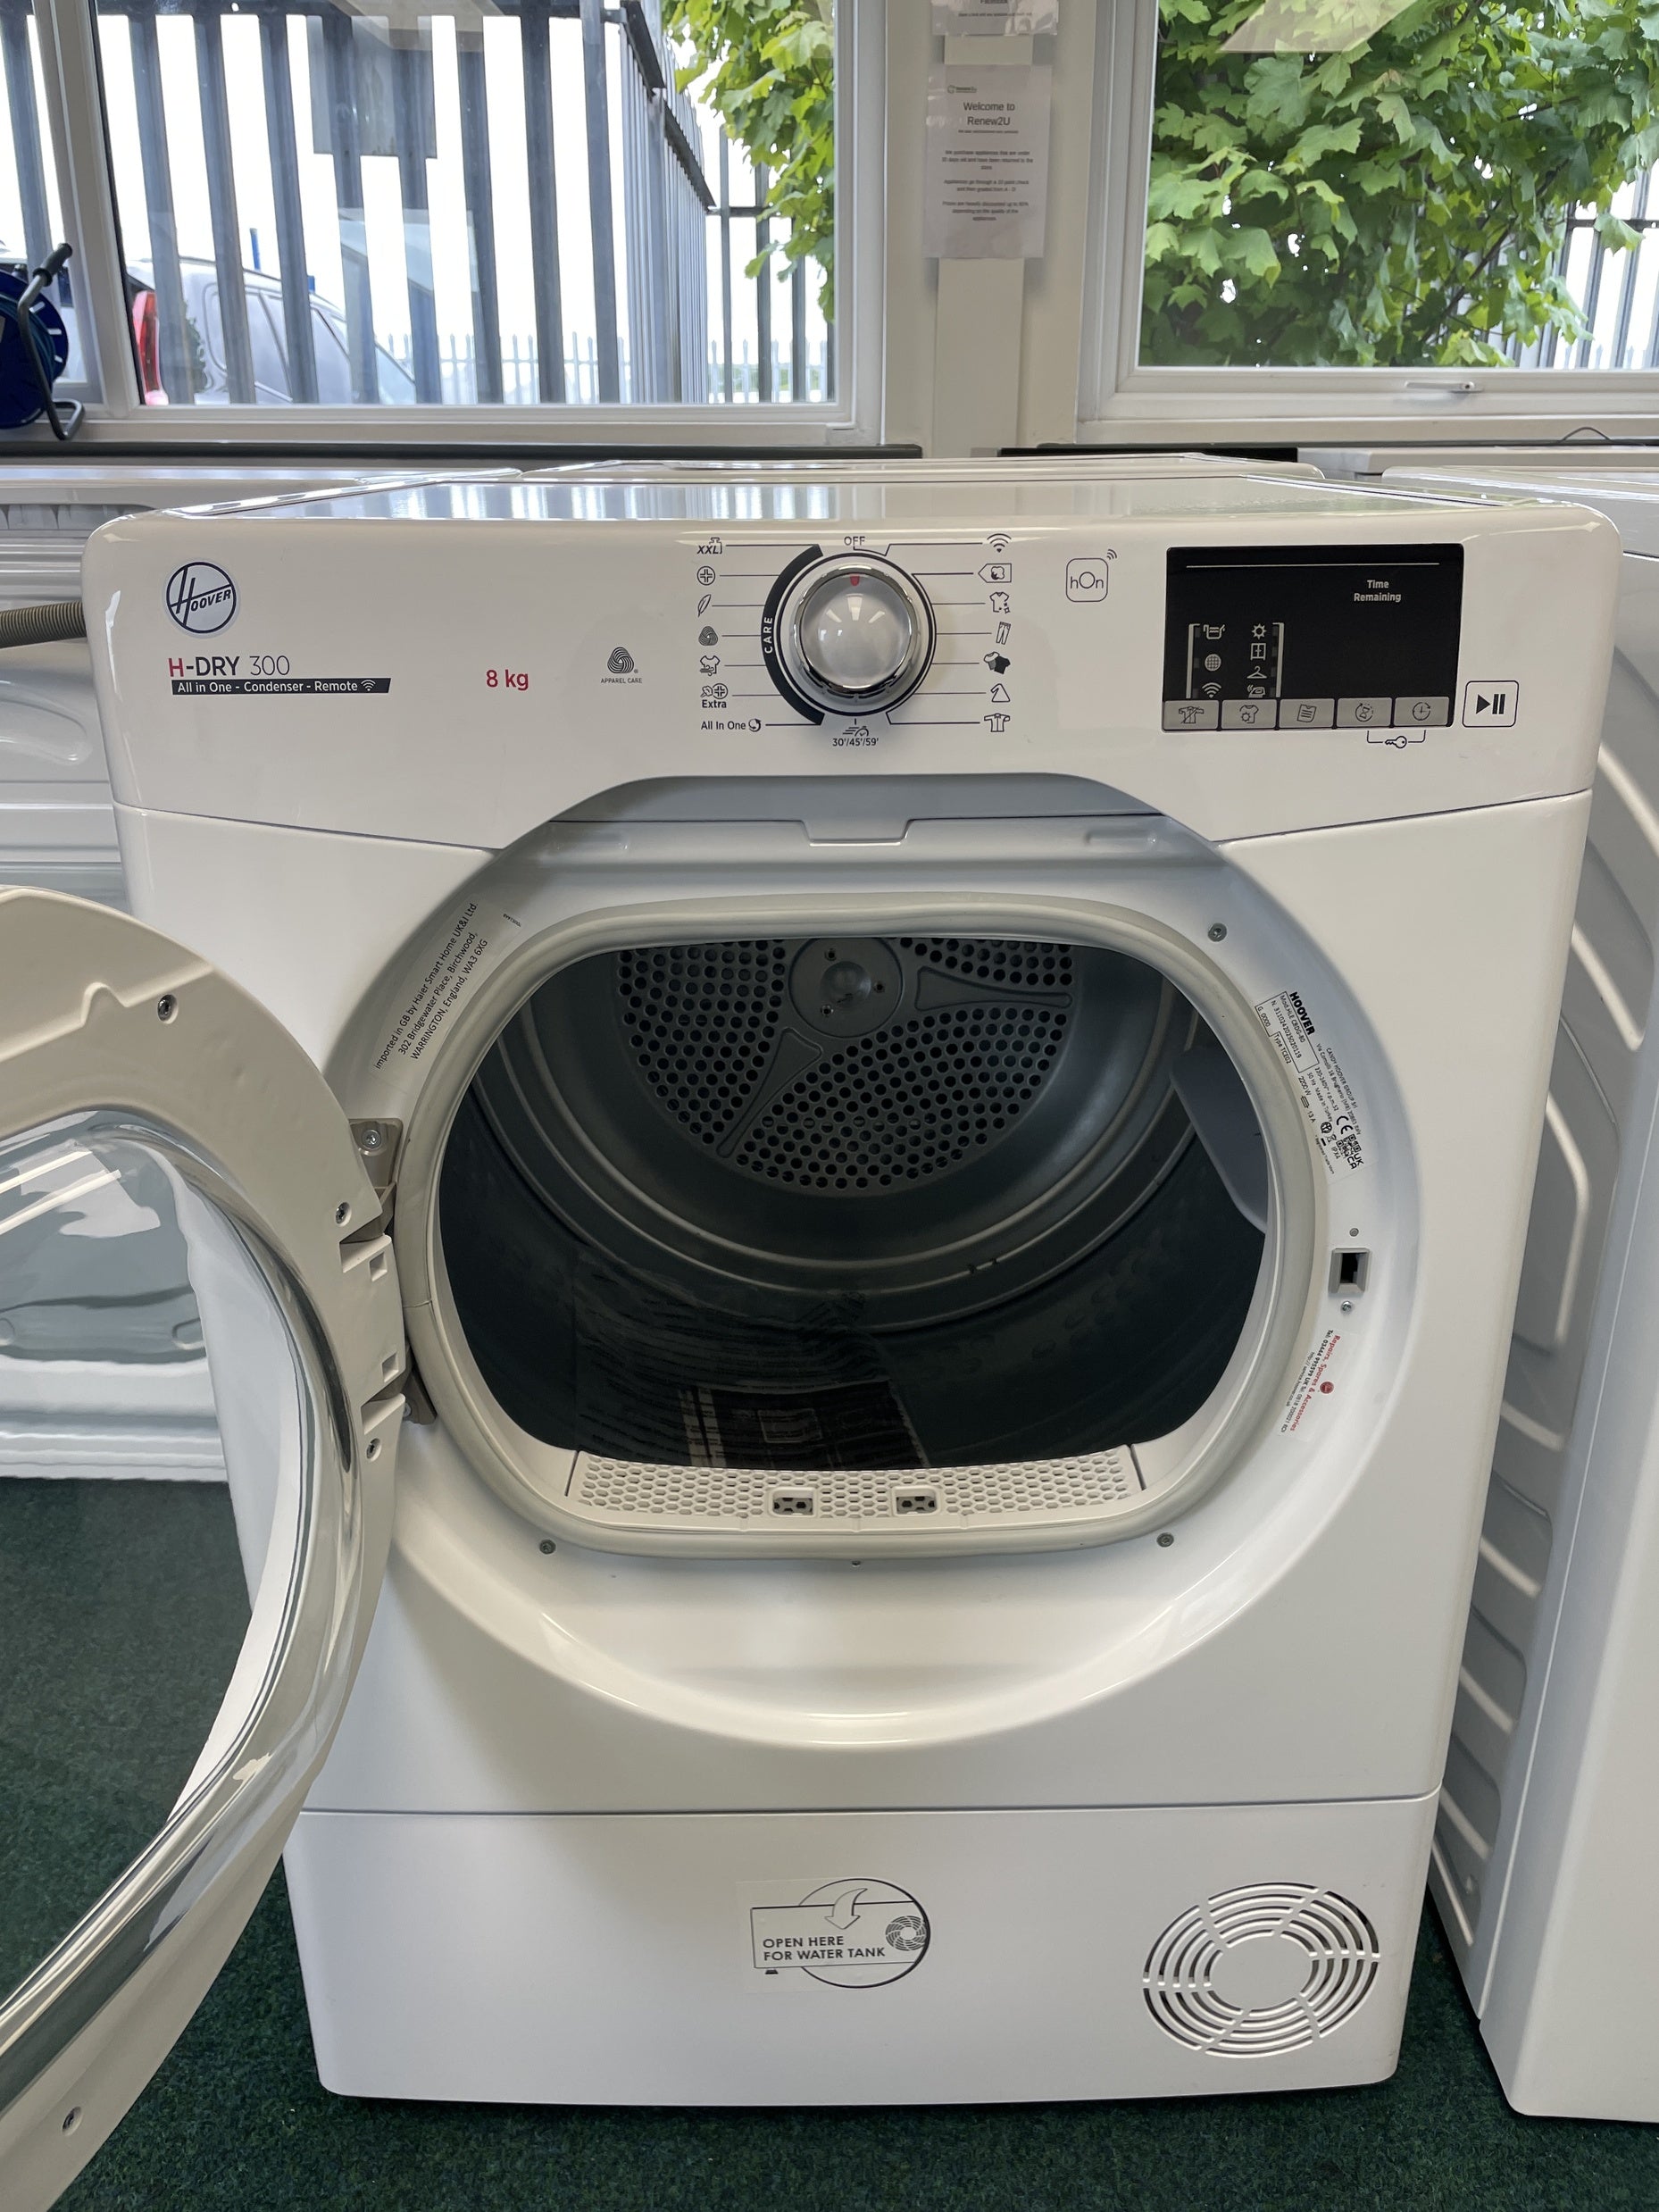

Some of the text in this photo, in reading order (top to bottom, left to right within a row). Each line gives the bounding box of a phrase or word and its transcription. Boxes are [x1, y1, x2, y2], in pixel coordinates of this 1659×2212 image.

[963, 102, 1015, 112] Welcome to
[966, 116, 1011, 127] Renew2U
[844, 536, 866, 547] OFF
[696, 545, 719, 555] XXL
[1070, 572, 1104, 589] hOn
[1366, 580, 1389, 588] Time
[1354, 592, 1402, 603] Remaining
[763, 616, 775, 654] CARE
[168, 655, 290, 677] H-DRY 300
[178, 682, 192, 693] All
[195, 682, 206, 693] in
[209, 682, 232, 693] One
[244, 680, 304, 693] Condenser
[314, 680, 358, 692] Remote
[486, 668, 529, 691] 8 kg
[701, 700, 727, 709] Extra
[701, 720, 746, 730] All In One
[438, 938, 456, 961] Home
[425, 961, 443, 984] Smart
[398, 932, 478, 1055] 302 Bridgewater Place, Birchwood,
[411, 939, 488, 1059] WARRINGTON, England, WA3 6XG
[413, 984, 429, 1005] Haier
[406, 1005, 418, 1015] by
[1289, 991, 1315, 1036] HOOVER
[399, 1014, 411, 1026] GB
[396, 1028, 404, 1036] in
[1274, 1033, 1283, 1048] Type
[1322, 1335, 1341, 1362] Repairs,
[1311, 1364, 1327, 1386] Spares
[1289, 1394, 1312, 1432] Accessories
[763, 1935, 844, 1948] OPEN HERE
[763, 1947, 886, 1961] FOR WATER TANK
